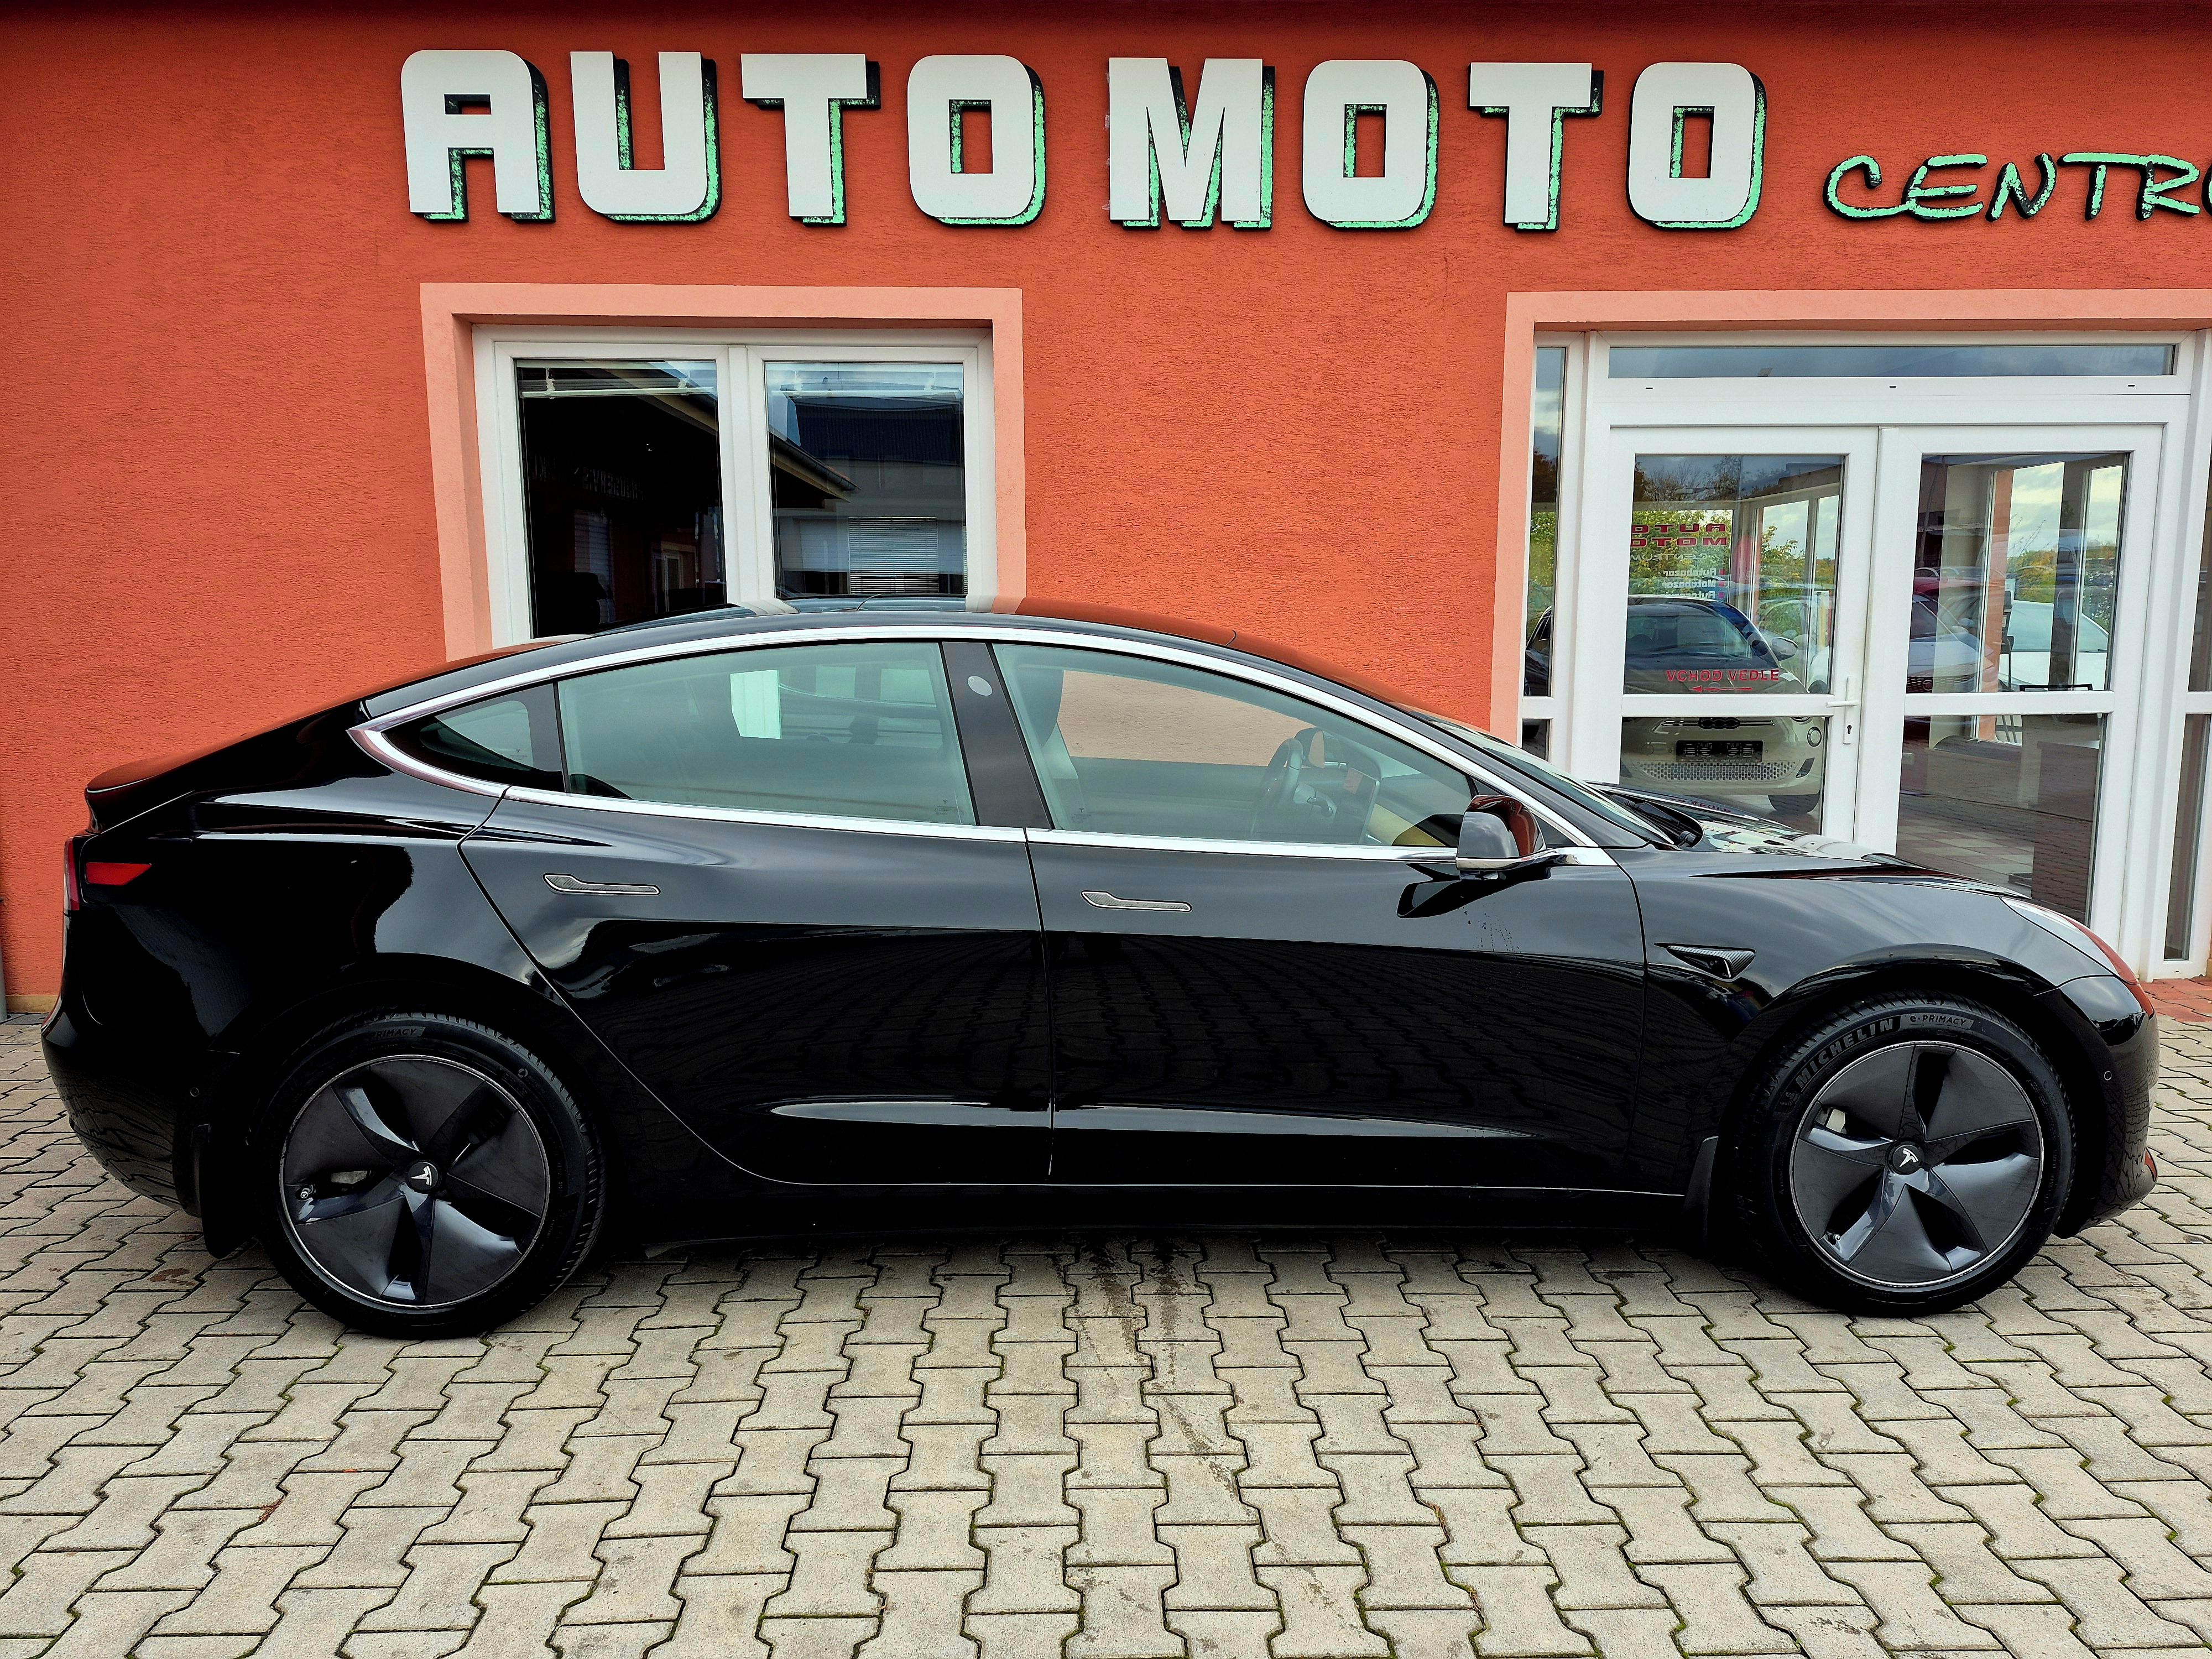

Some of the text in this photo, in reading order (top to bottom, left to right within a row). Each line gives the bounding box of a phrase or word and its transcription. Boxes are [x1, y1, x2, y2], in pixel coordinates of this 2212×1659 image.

[400, 49, 1045, 226] AUTO
[1108, 57, 1767, 231] MOTO
[1666, 668, 1779, 682] VCHOD VEDLE
[1795, 1019, 1893, 1089] MICHELIN
